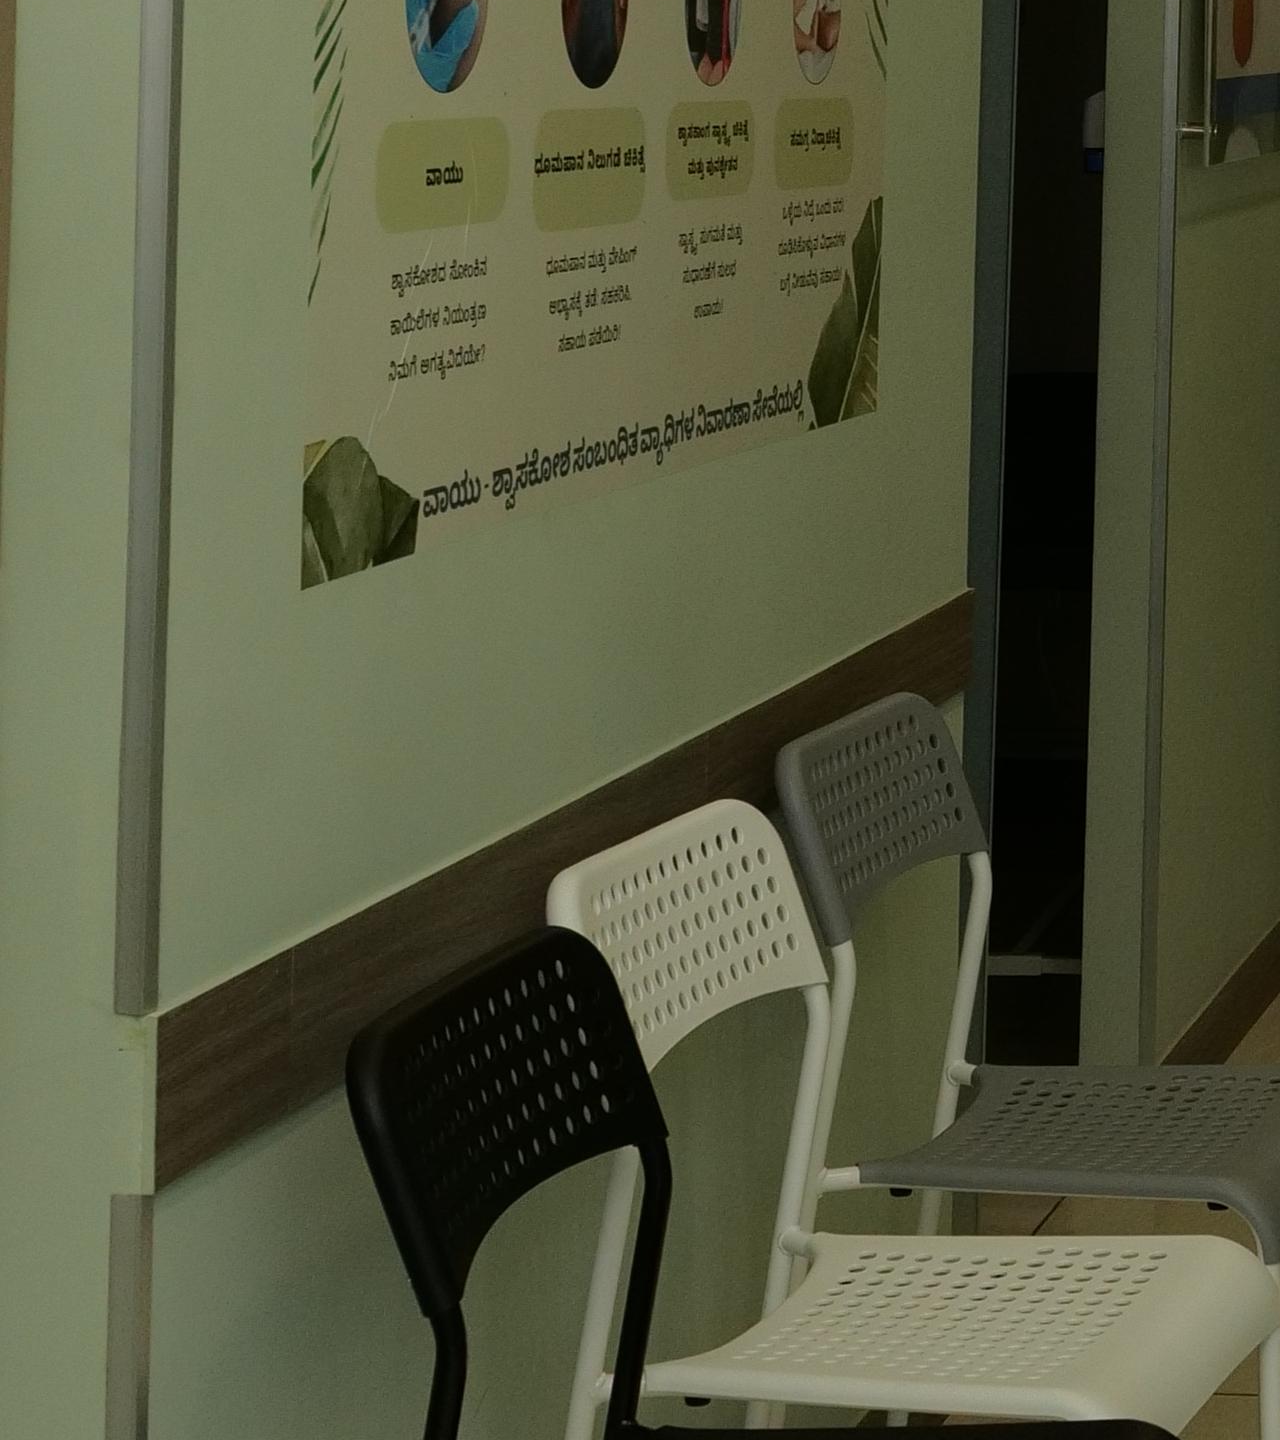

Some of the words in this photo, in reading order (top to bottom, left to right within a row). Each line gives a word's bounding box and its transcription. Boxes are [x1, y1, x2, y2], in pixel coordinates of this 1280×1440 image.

[425, 160, 463, 186] ವಾಯು
[422, 468, 481, 518] ವಾಯು
[491, 440, 571, 510] ಶ್ವಾಸಕೋಶ
